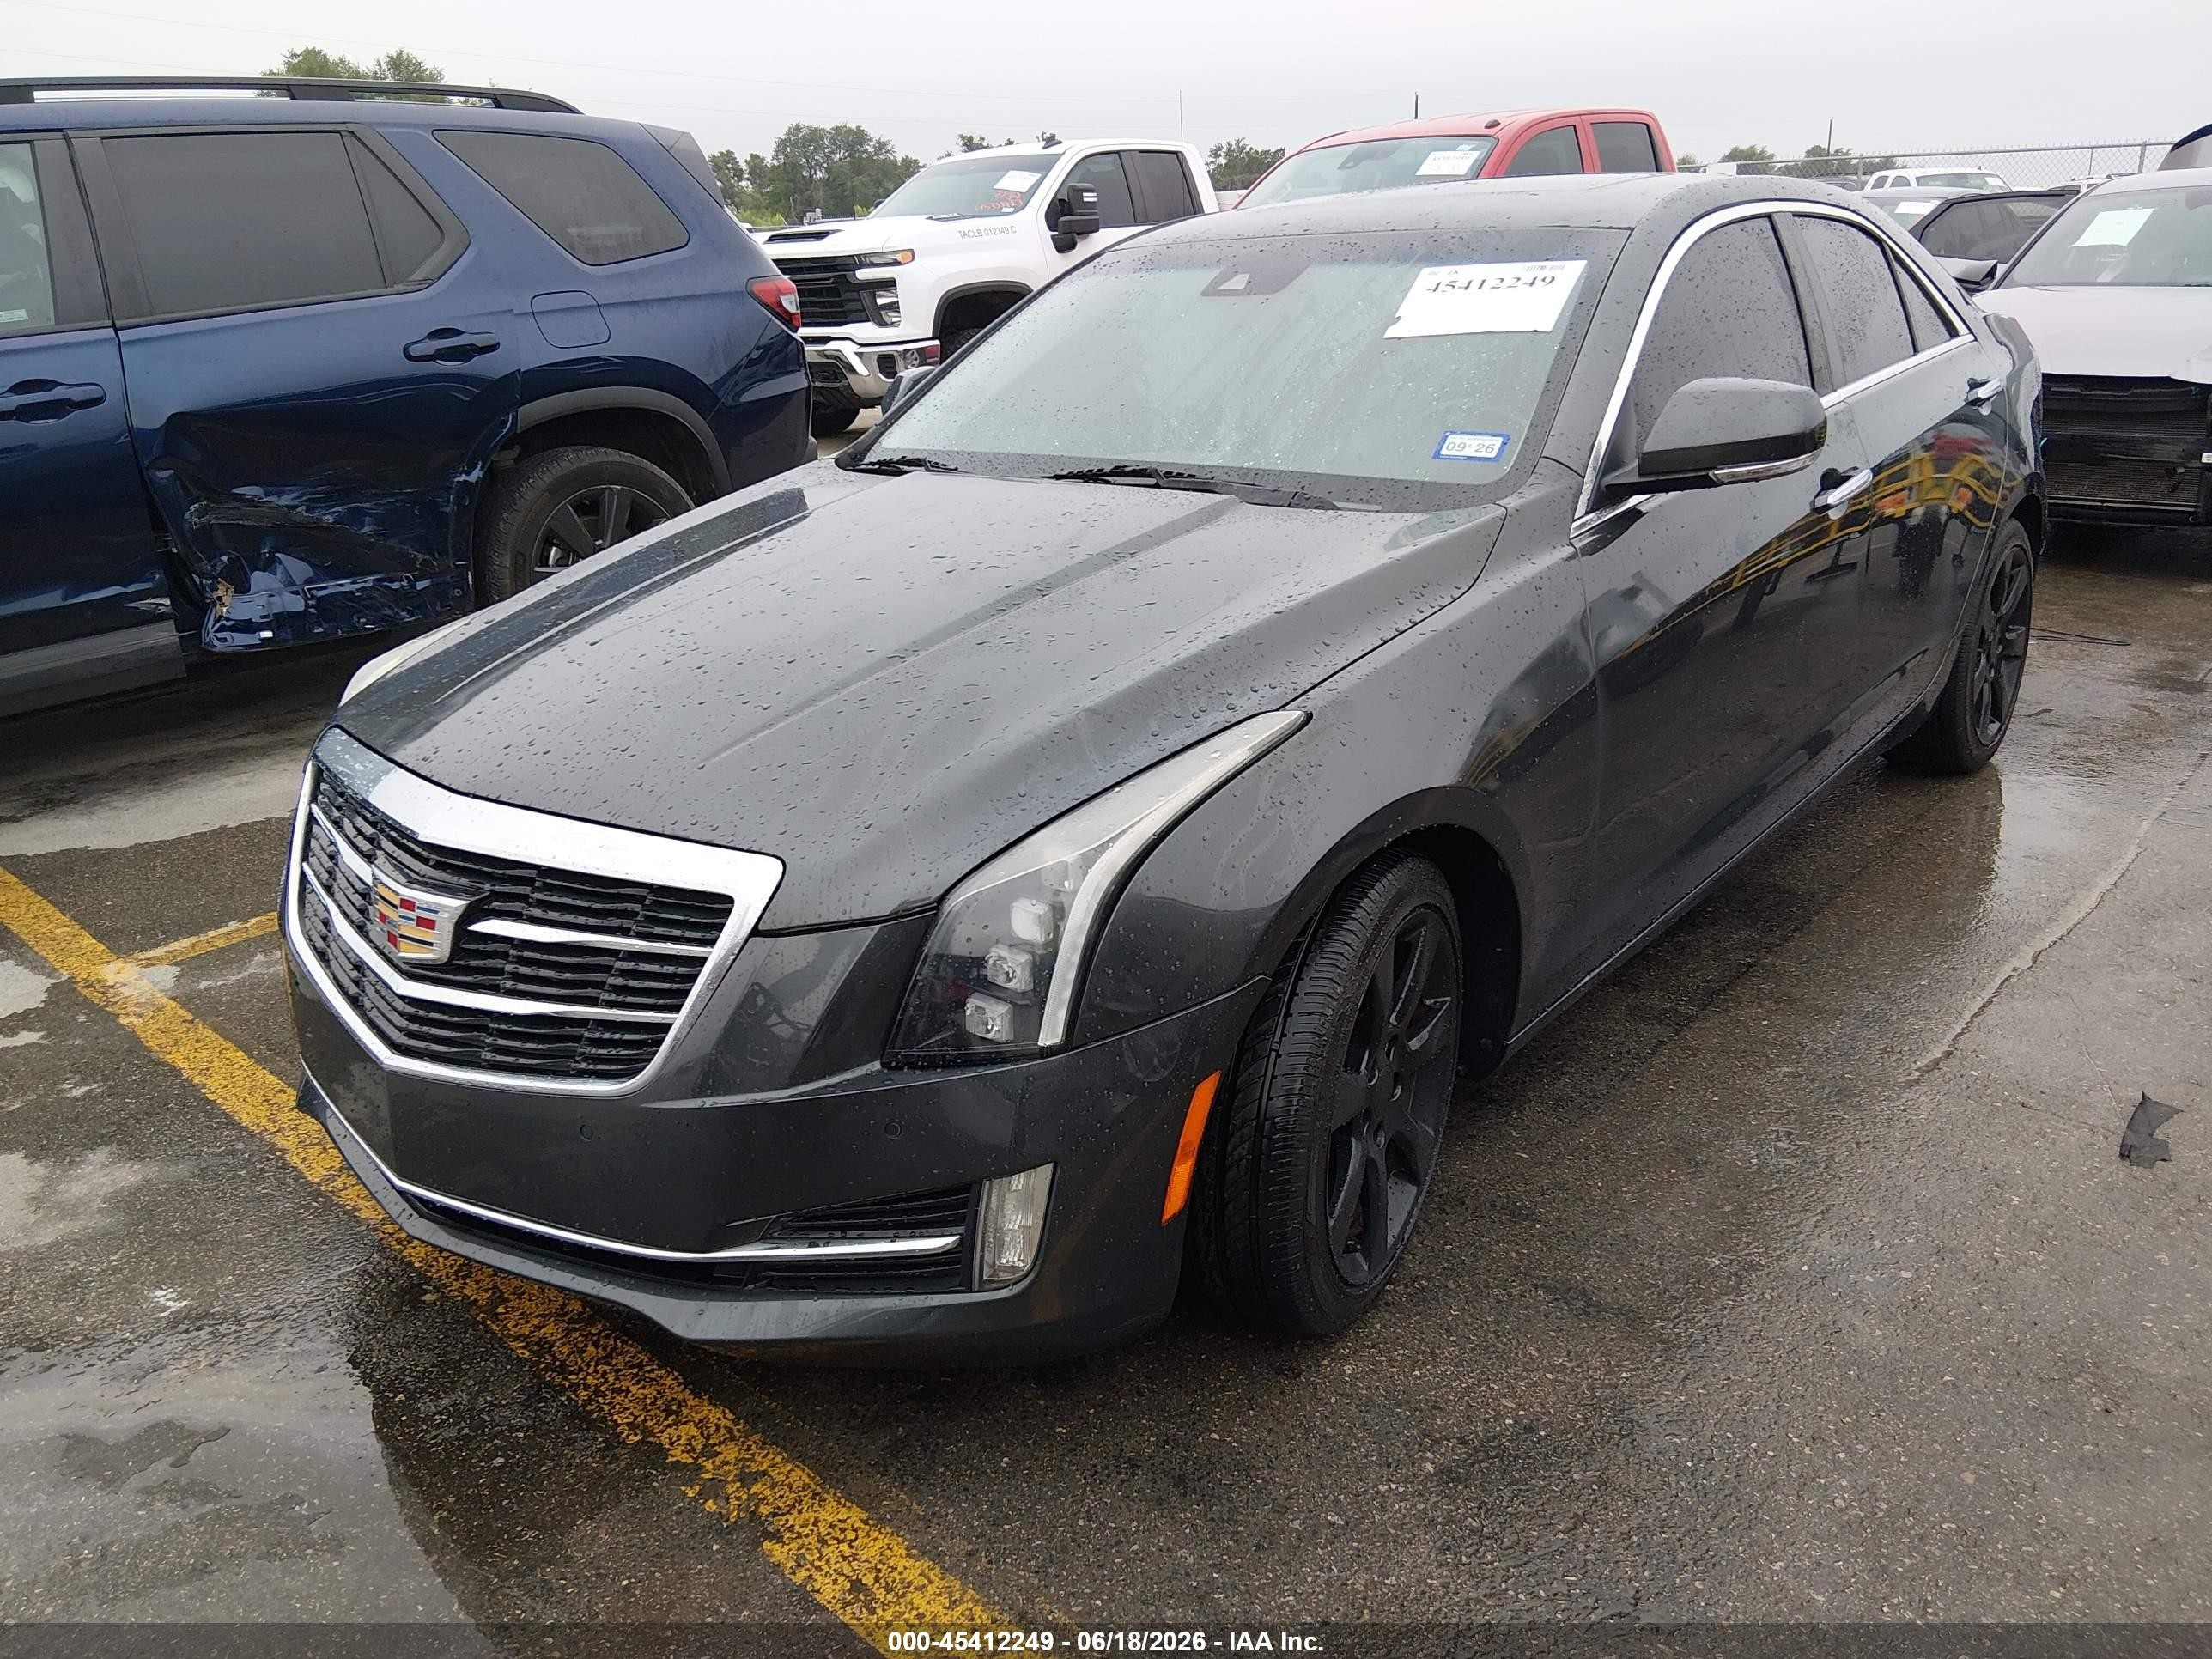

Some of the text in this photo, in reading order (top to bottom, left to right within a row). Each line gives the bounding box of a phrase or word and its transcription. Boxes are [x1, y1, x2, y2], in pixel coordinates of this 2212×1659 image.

[957, 228, 982, 240] TACLB
[1011, 225, 1017, 234] C
[1426, 276, 1555, 293] 45412249
